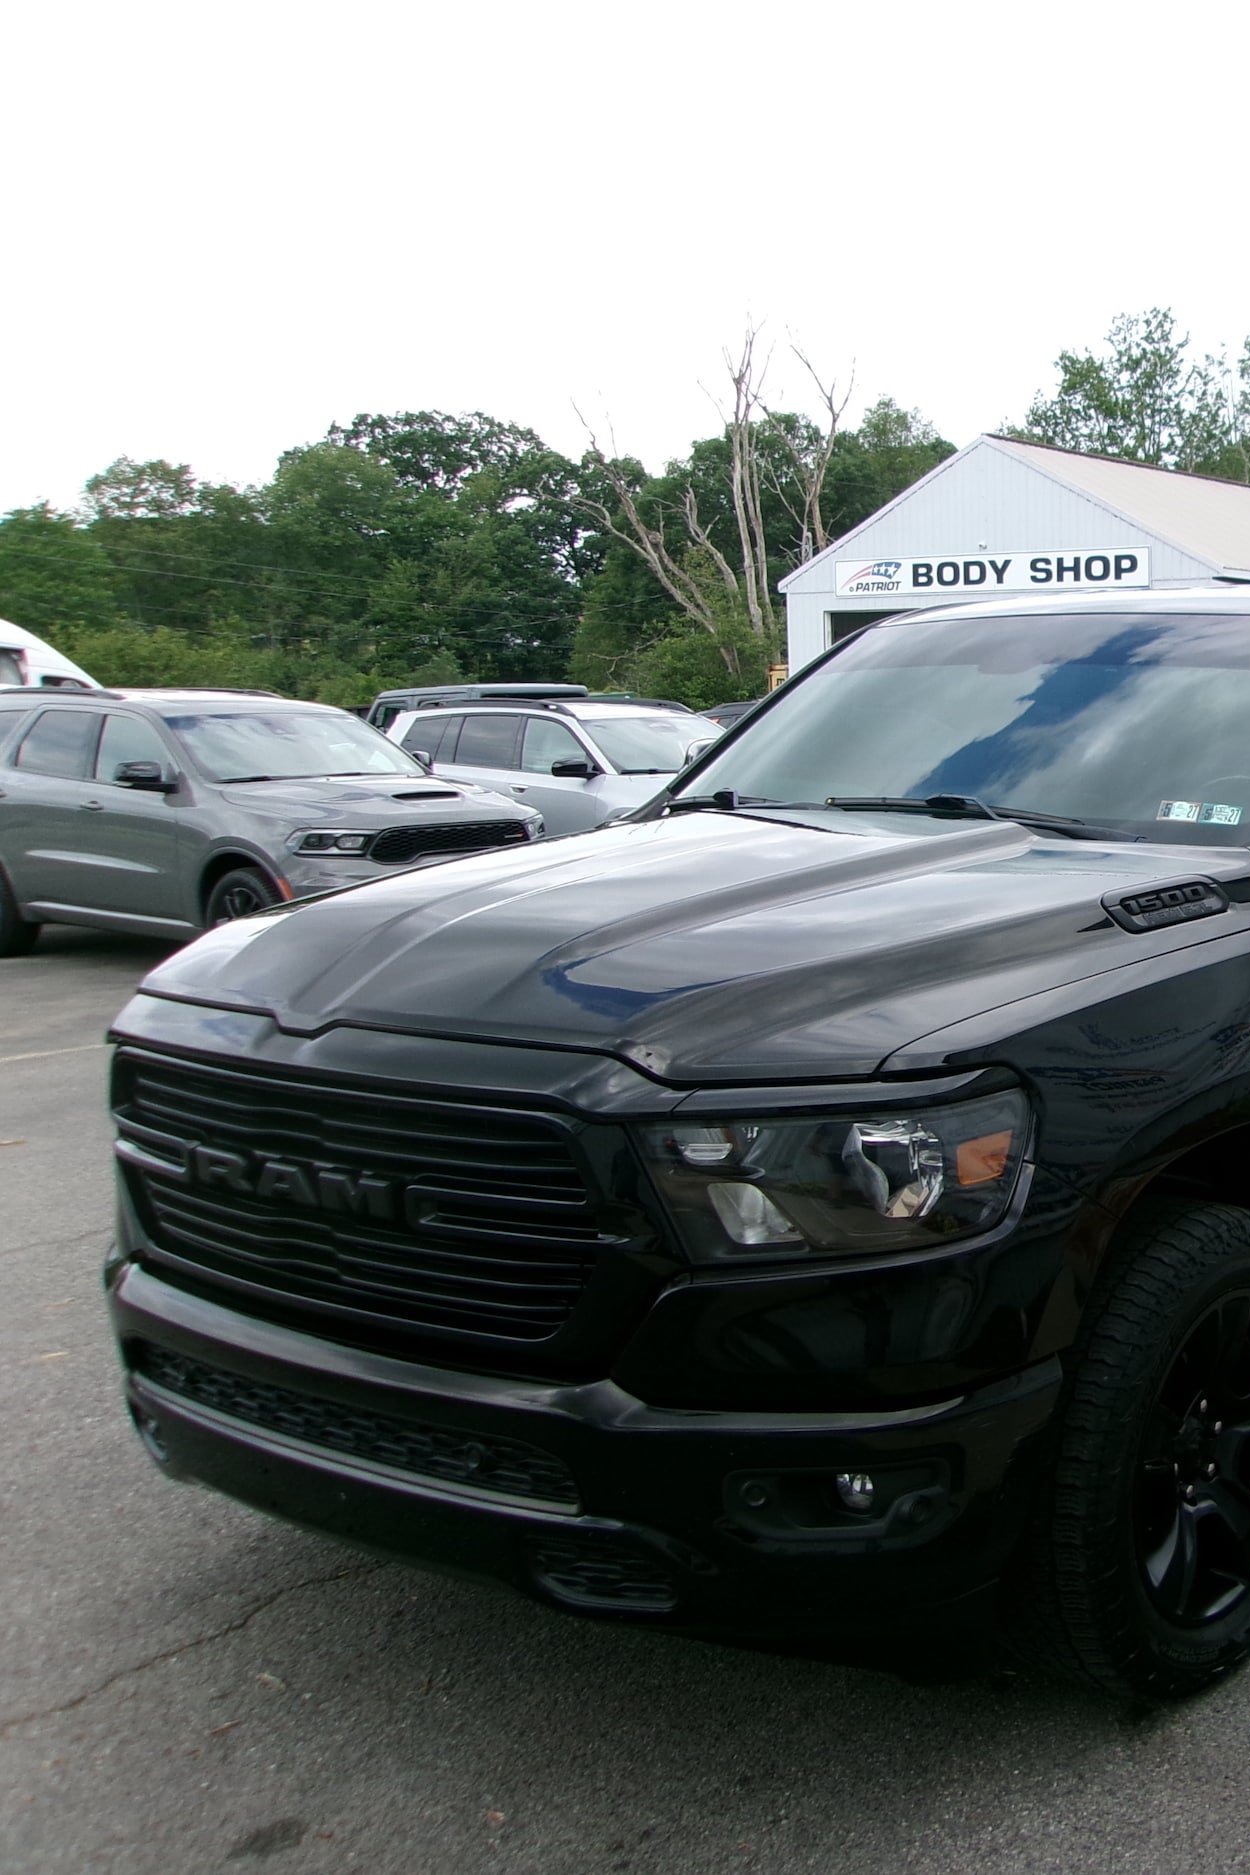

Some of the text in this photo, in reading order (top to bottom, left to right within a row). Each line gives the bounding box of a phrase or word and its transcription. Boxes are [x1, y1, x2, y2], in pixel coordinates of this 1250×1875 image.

[911, 554, 1139, 588] BODY SHOP
[855, 581, 902, 593] PATRIOT
[1186, 804, 1198, 819] 27
[1227, 808, 1240, 823] 27
[1122, 885, 1206, 915] 1500
[194, 1144, 395, 1220] RAM
